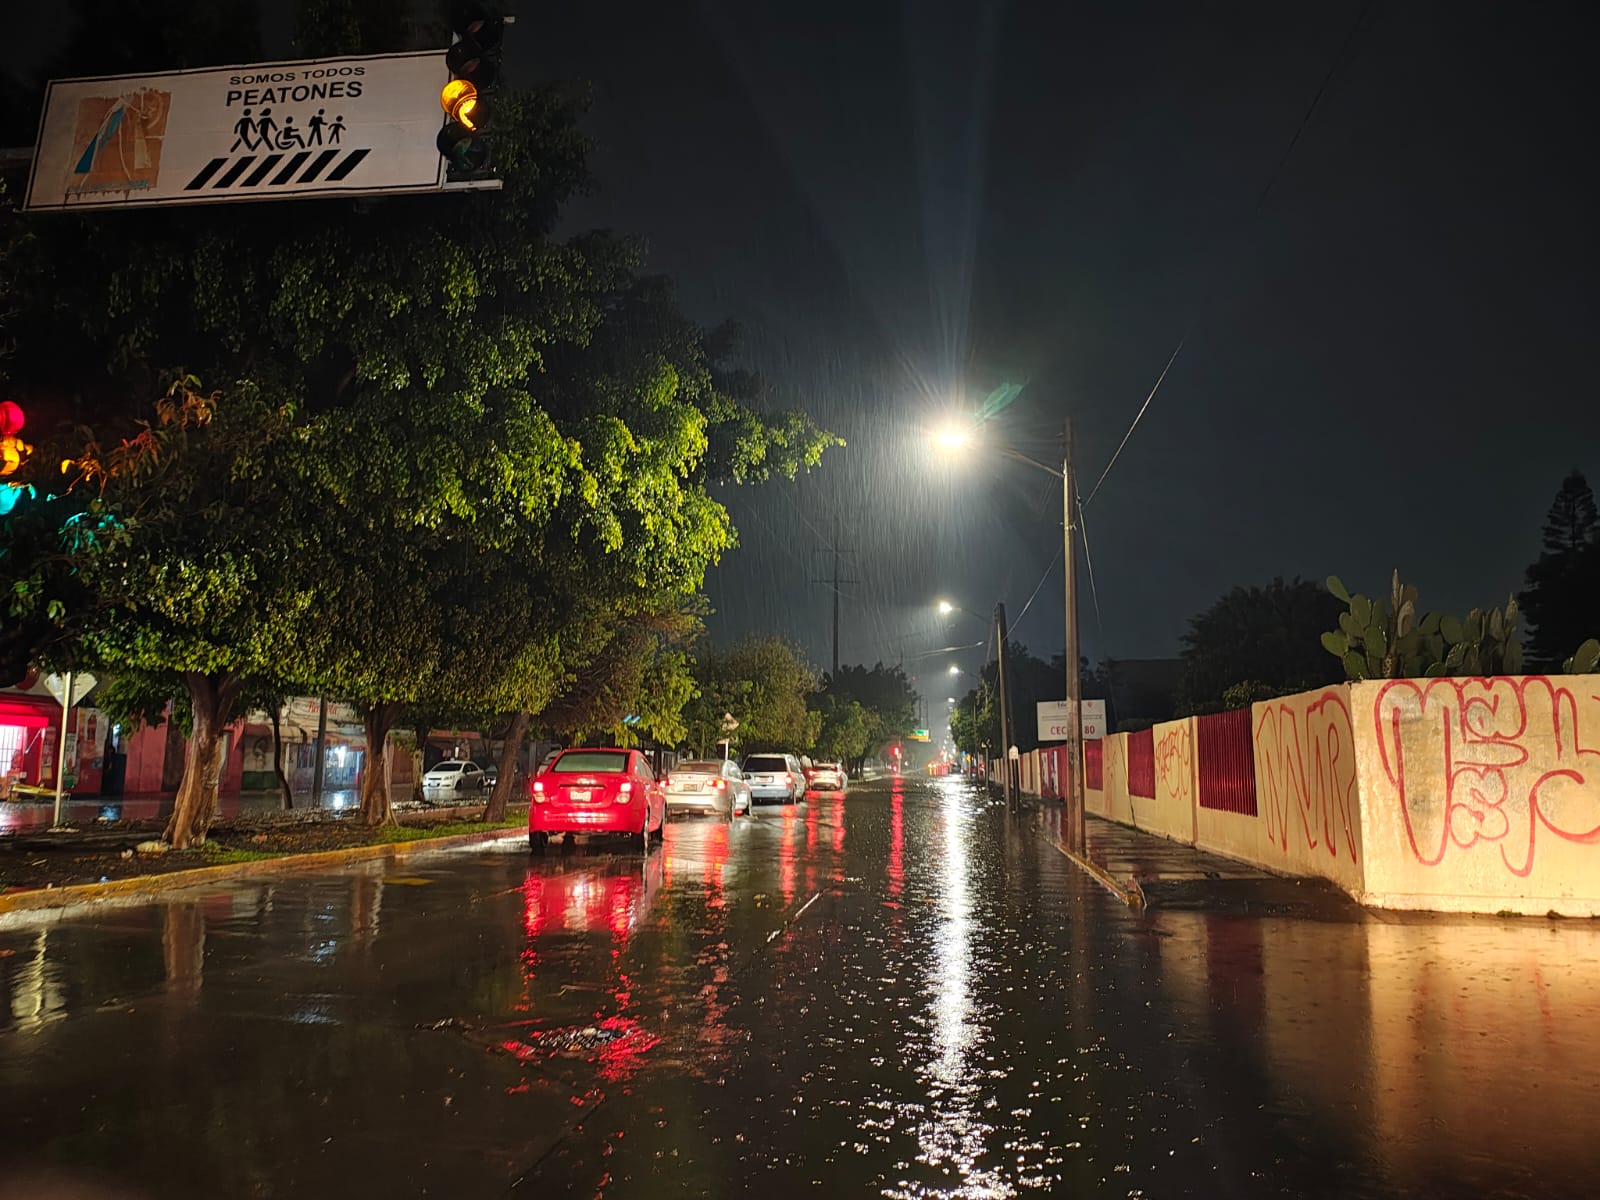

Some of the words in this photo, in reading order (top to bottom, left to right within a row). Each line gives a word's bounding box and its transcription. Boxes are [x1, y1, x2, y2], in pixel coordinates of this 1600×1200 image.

[229, 72, 296, 85] SOMOS
[302, 67, 366, 79] TODOS
[226, 81, 363, 107] PEATONES
[1084, 725, 1096, 735] 80
